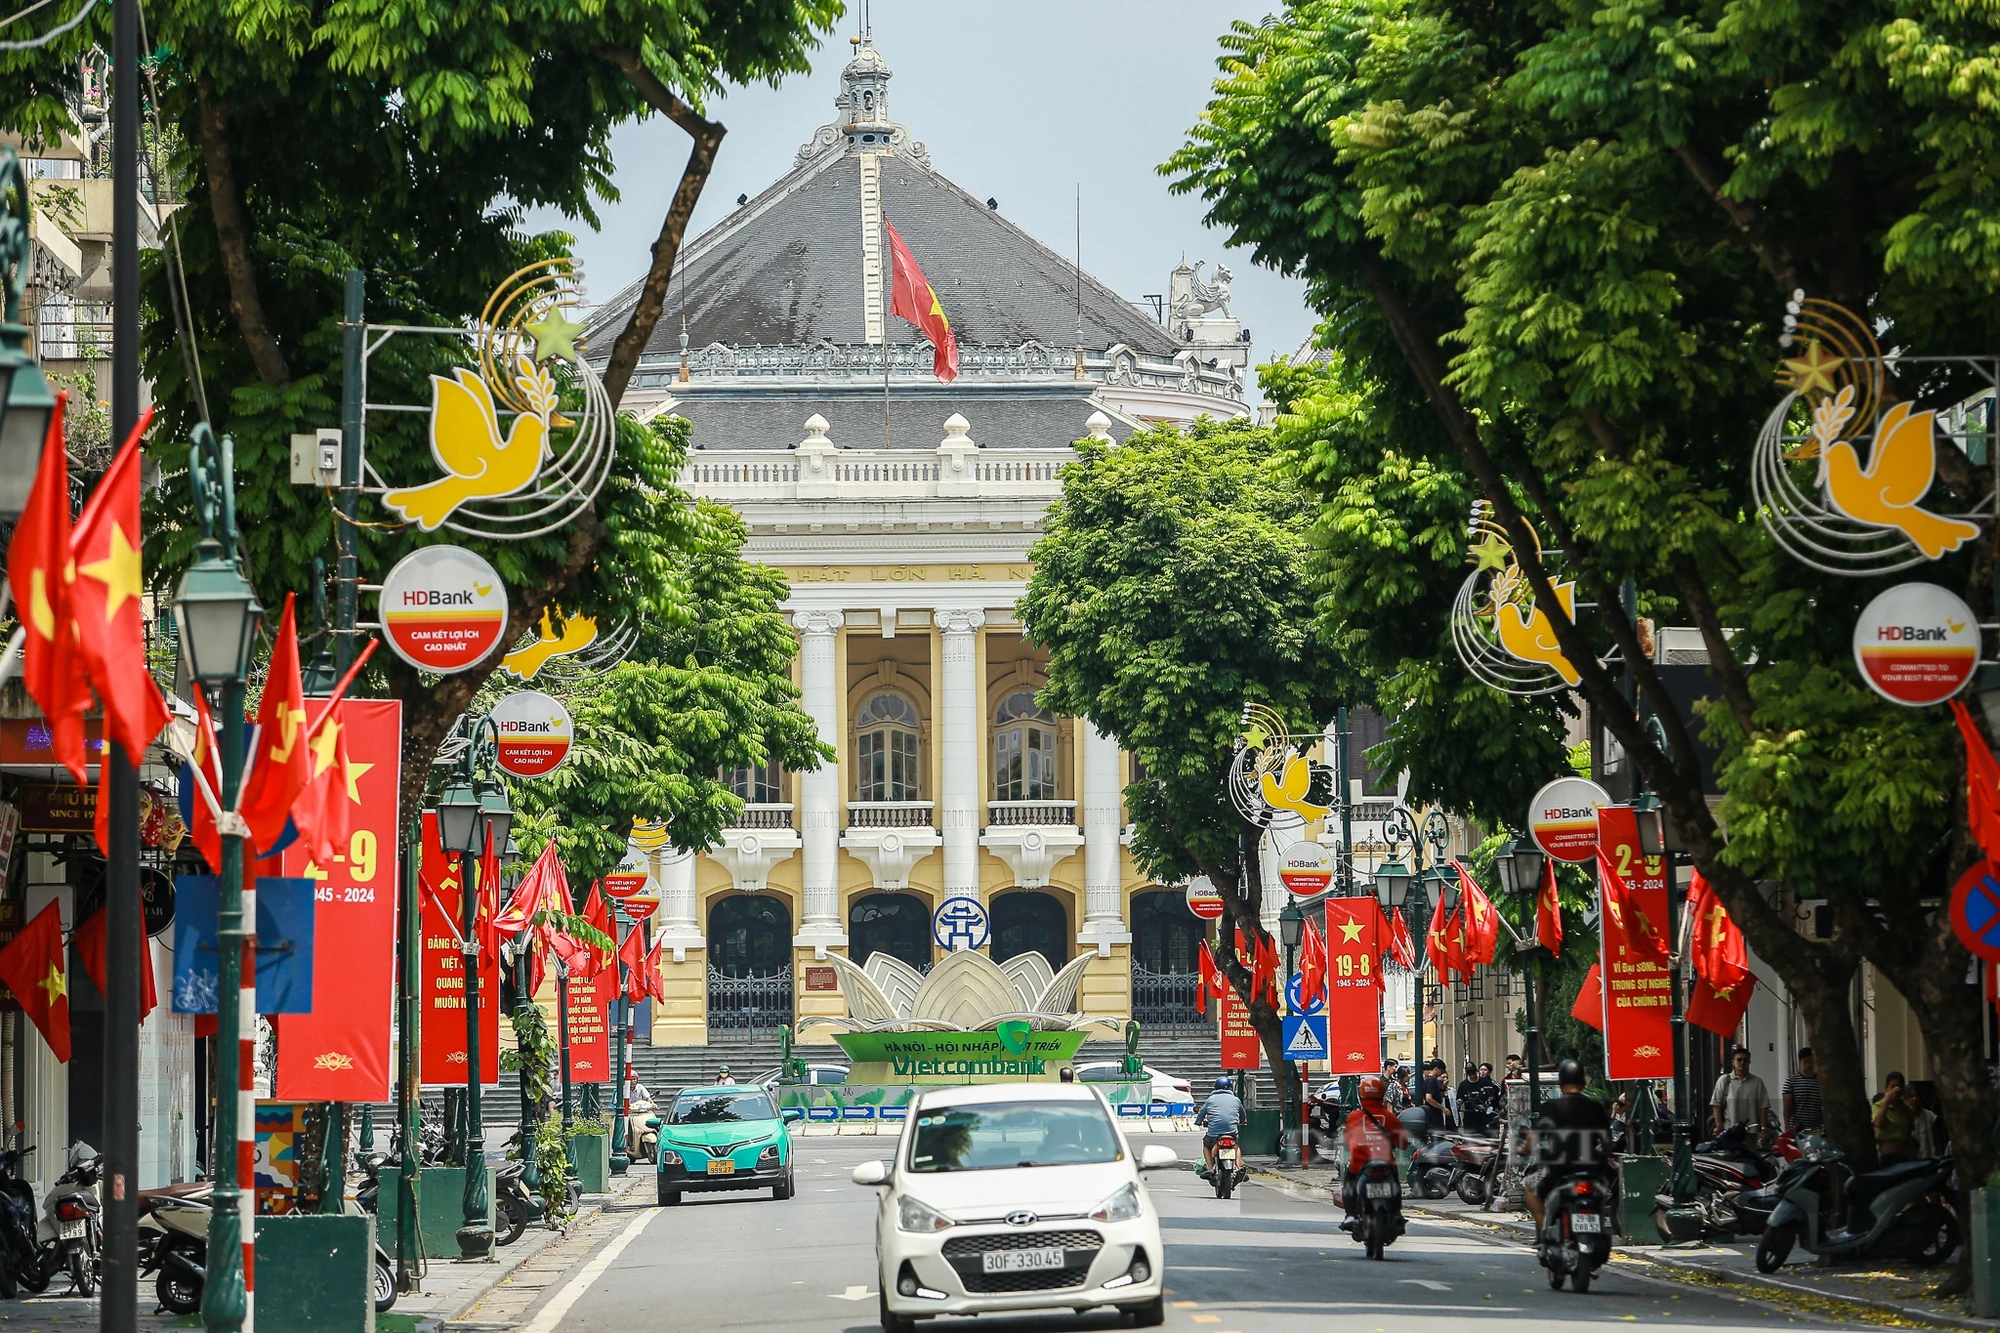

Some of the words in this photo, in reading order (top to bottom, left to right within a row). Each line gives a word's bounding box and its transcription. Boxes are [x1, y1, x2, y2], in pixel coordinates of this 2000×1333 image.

[797, 565, 850, 582] HÁT
[871, 565, 927, 581] LỚN
[949, 564, 986, 580] HÀ
[403, 590, 474, 605] HDBank
[411, 631, 431, 639] CAM
[432, 629, 449, 639] KẾT
[449, 631, 463, 640] LỢI
[464, 629, 479, 638] ÍCH
[1877, 626, 1948, 641] HDBank
[424, 643, 444, 652] CAO
[444, 641, 467, 651] NHẤT
[501, 721, 550, 732] HDBank
[519, 748, 531, 756] KẾT
[50, 809, 80, 818] SINCE
[1544, 807, 1593, 820] HDBank
[1555, 833, 1587, 841] COMMITTED
[1287, 860, 1320, 868] HDBank
[1643, 880, 1664, 889] 2024
[344, 887, 375, 902] 2024
[428, 935, 450, 949] ĐẢNG
[441, 956, 458, 971] VIỆT
[1335, 954, 1370, 977] 19-8
[436, 977, 463, 989] QUANG
[1336, 979, 1351, 987] 1945
[1355, 978, 1370, 987] 2024
[1612, 979, 1636, 990] TRONG
[1637, 978, 1648, 991] SỰ
[1649, 976, 1671, 991] NGHIỆ
[434, 995, 459, 1008] MUÔN
[1616, 994, 1632, 1007] CỦA
[1633, 994, 1658, 1007] CHÚNG
[1659, 995, 1668, 1005] TA
[884, 1041, 902, 1052] HÀ
[902, 1041, 926, 1055] NỘI
[935, 1041, 959, 1055] HỘI
[962, 1040, 999, 1054] NHẬP
[1033, 1038, 1062, 1051] TRIỂN
[891, 1054, 1046, 1075] Vietcombank
